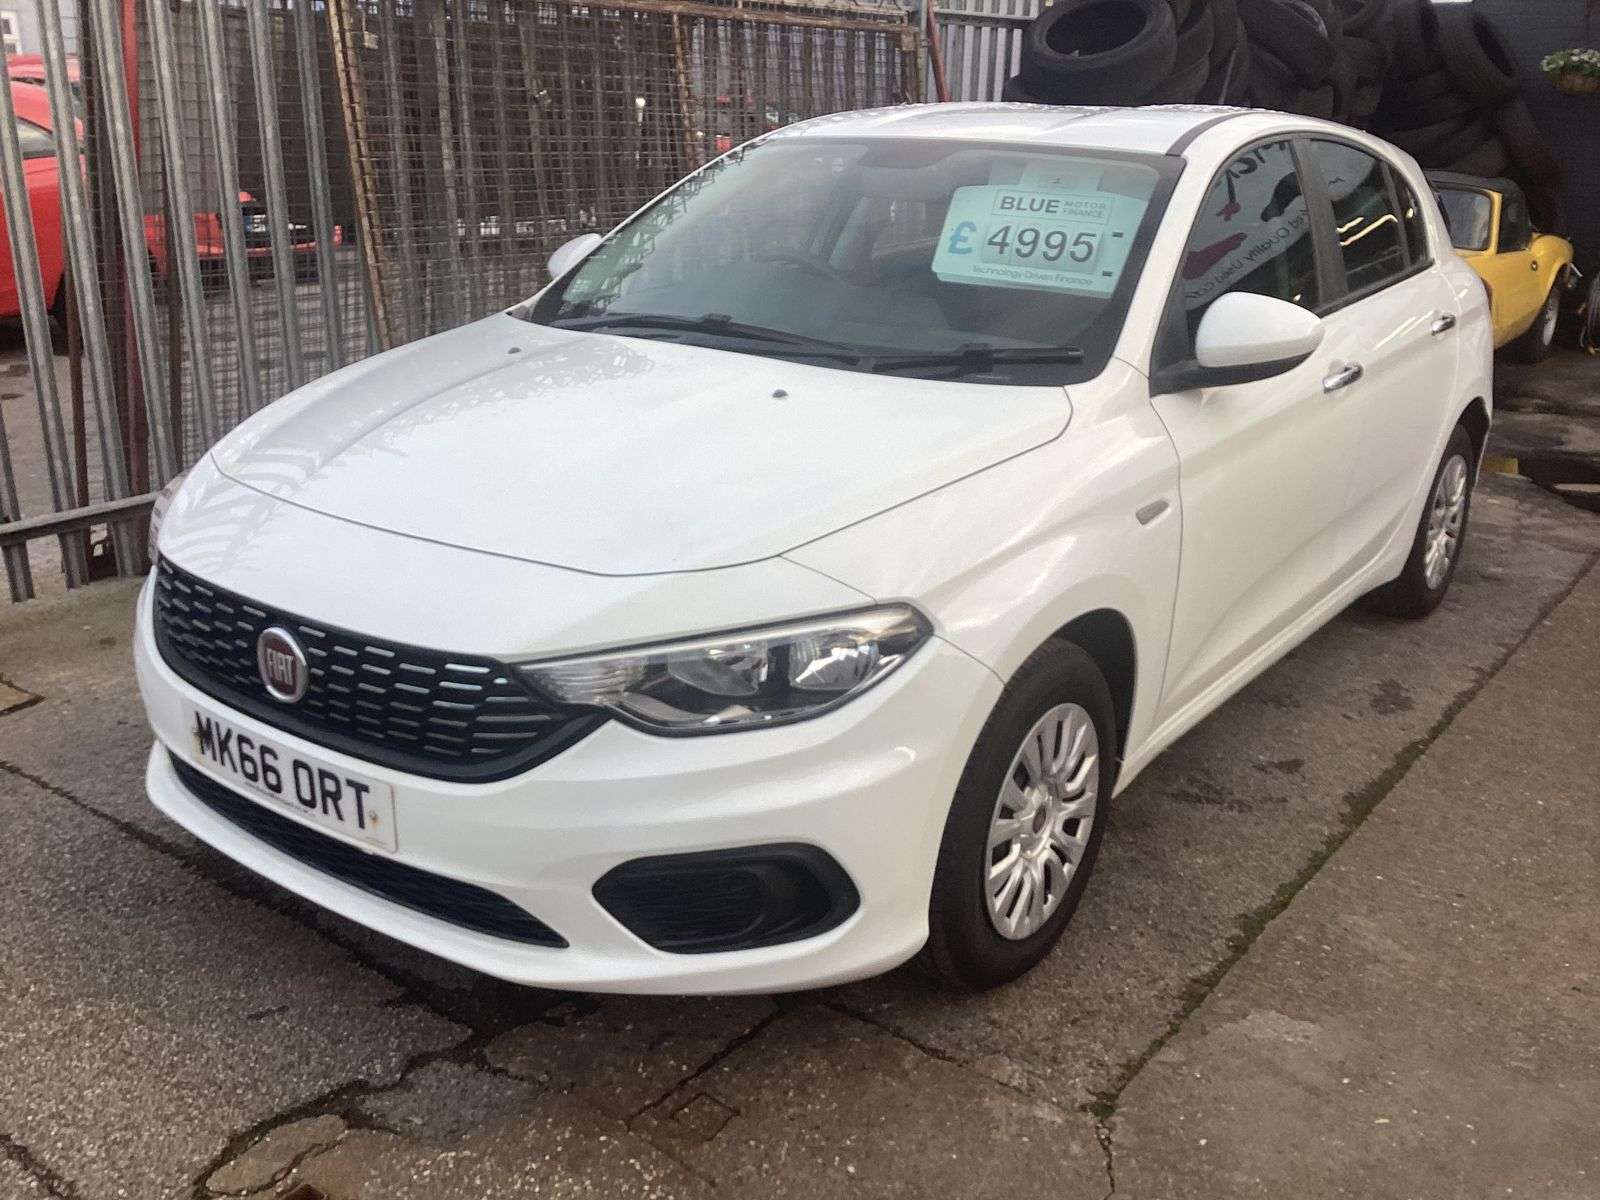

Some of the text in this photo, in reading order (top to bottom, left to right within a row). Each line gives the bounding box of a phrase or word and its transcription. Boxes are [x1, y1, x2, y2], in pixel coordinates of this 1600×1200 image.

[1000, 195, 1061, 213] BLUE
[1062, 208, 1105, 219] FINANCE
[1063, 199, 1107, 210] MOTOR
[948, 221, 1098, 263] £ 4995
[972, 264, 1093, 286] Technology Driven Finance
[267, 649, 294, 686] FIAT
[195, 711, 283, 794] MK66
[294, 758, 370, 829] ORT
